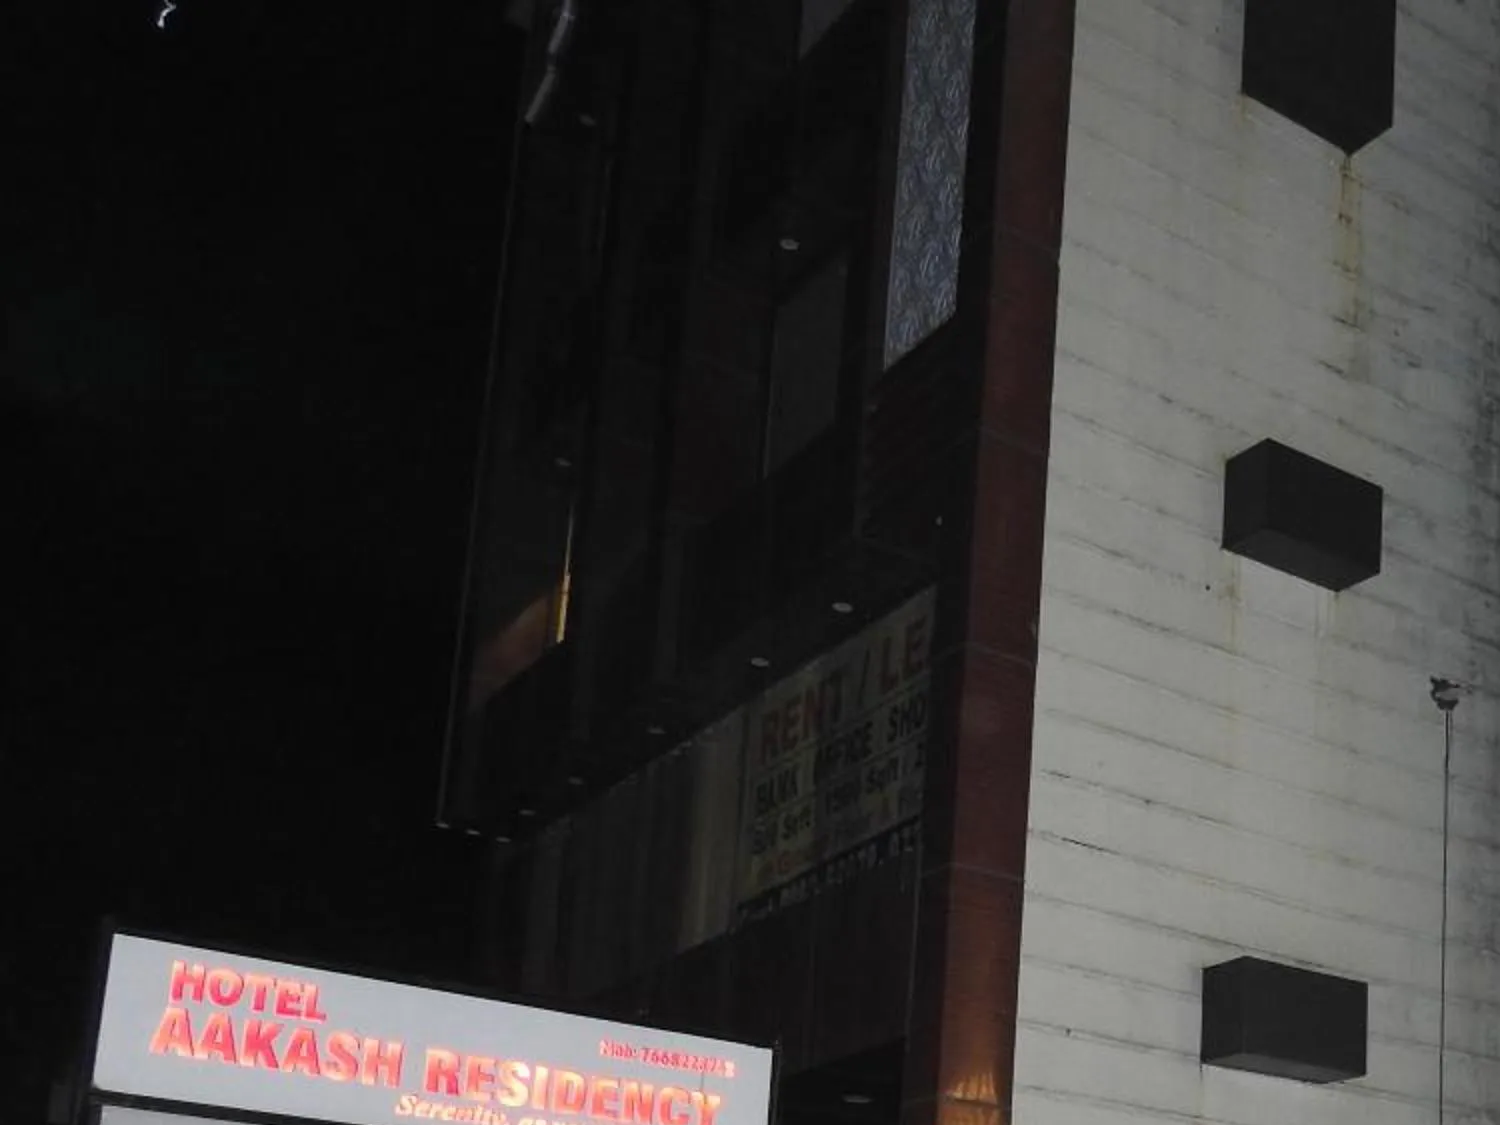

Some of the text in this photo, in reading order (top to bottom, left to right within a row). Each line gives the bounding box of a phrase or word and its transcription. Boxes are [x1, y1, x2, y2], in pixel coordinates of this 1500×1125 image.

[758, 670, 845, 766] RENT
[169, 960, 327, 1023] HOTEL
[150, 1006, 404, 1089] AAKASH
